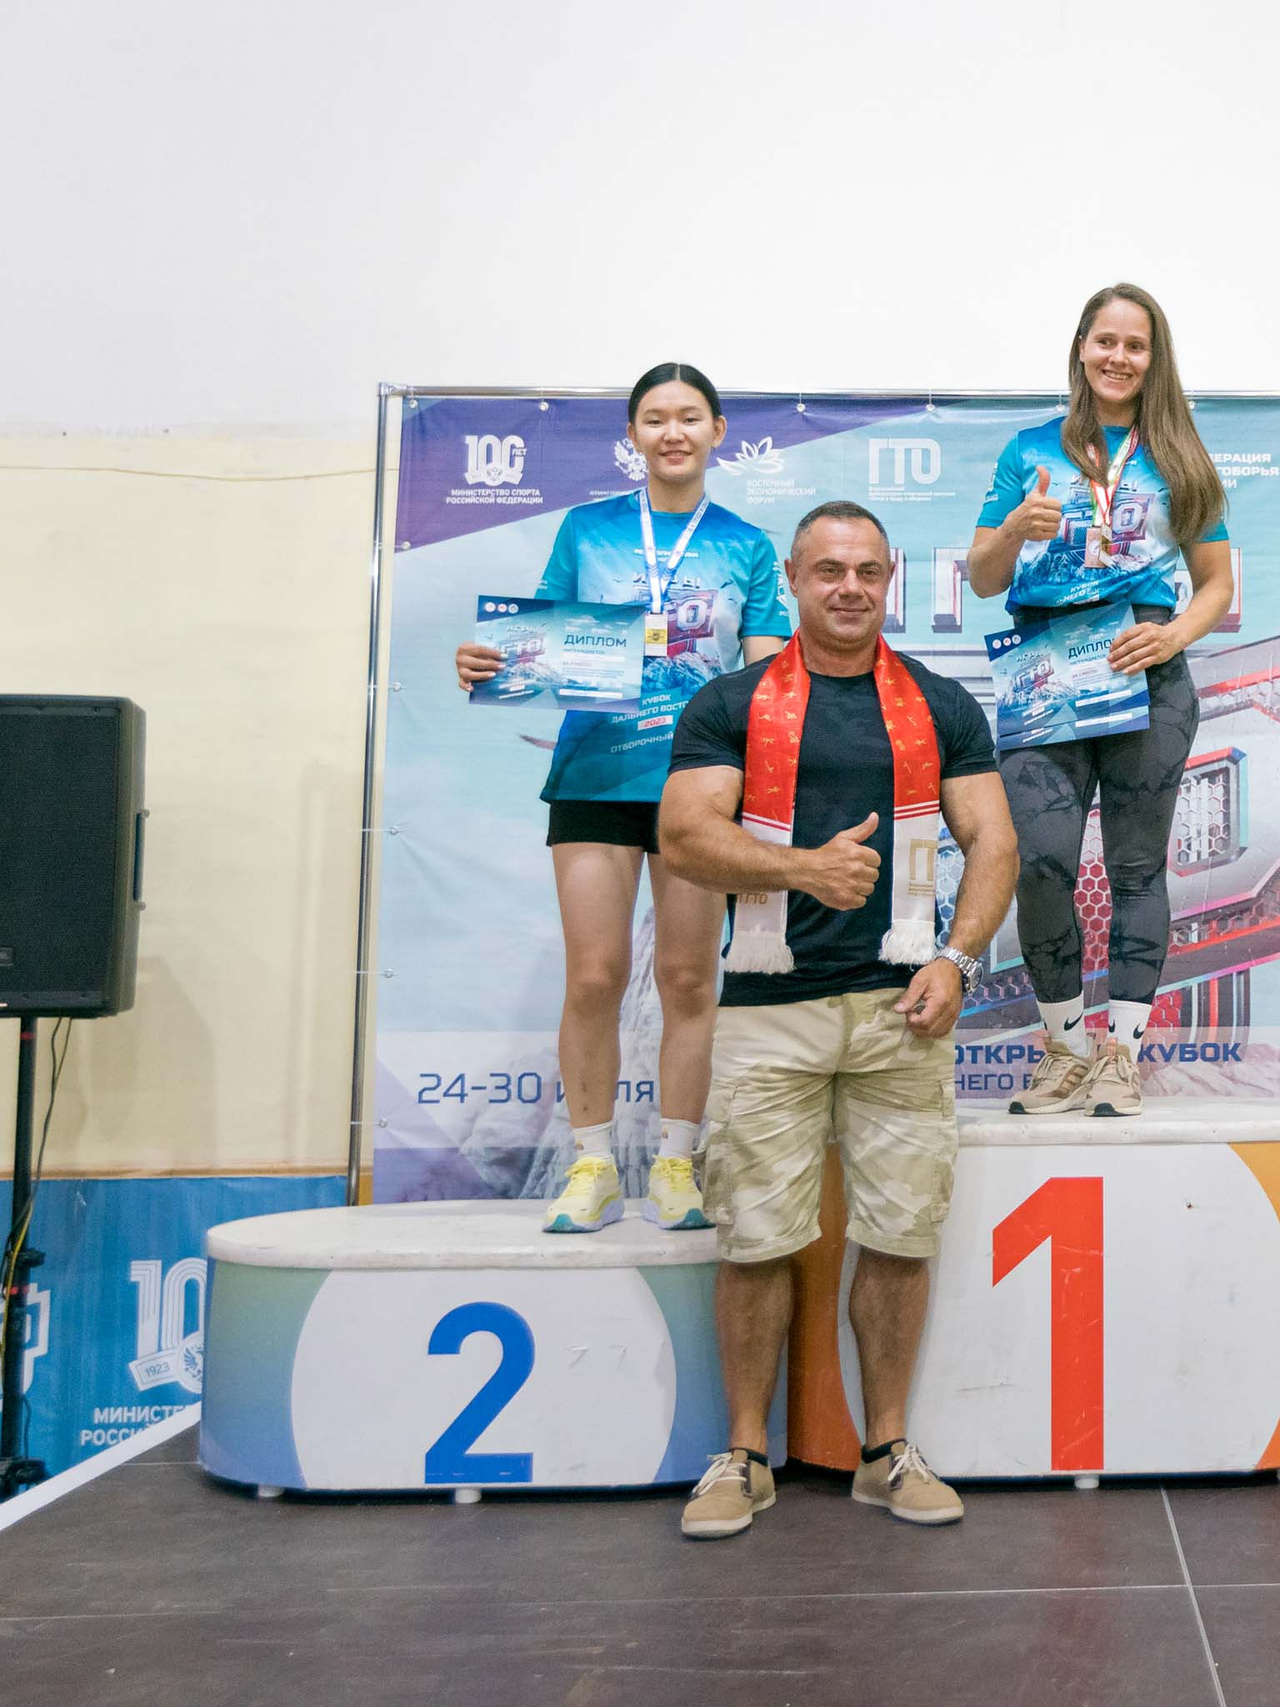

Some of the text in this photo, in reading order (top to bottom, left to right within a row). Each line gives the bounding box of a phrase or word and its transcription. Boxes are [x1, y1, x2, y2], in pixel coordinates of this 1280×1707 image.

[512, 448, 528, 456] ЛЕТ
[869, 438, 941, 484] ГТО
[446, 496, 544, 505] РОССИЙСКОЙ ФЕДЕРАЦИИ
[564, 634, 627, 648] ДИПЛОМ
[642, 694, 671, 706] КУБОК
[612, 706, 659, 725] ДАЛЬНЕГО
[644, 716, 667, 729] 2023
[611, 730, 674, 754] ОТБОРОЧНЫЙ
[1137, 1042, 1242, 1063] КУБОК
[418, 1072, 542, 1104] 24-30
[130, 1257, 207, 1358] 10
[992, 1177, 1104, 1471] 1
[145, 1362, 170, 1377] 1923
[424, 1301, 535, 1484] 2
[94, 1405, 186, 1424] МИНИСТ
